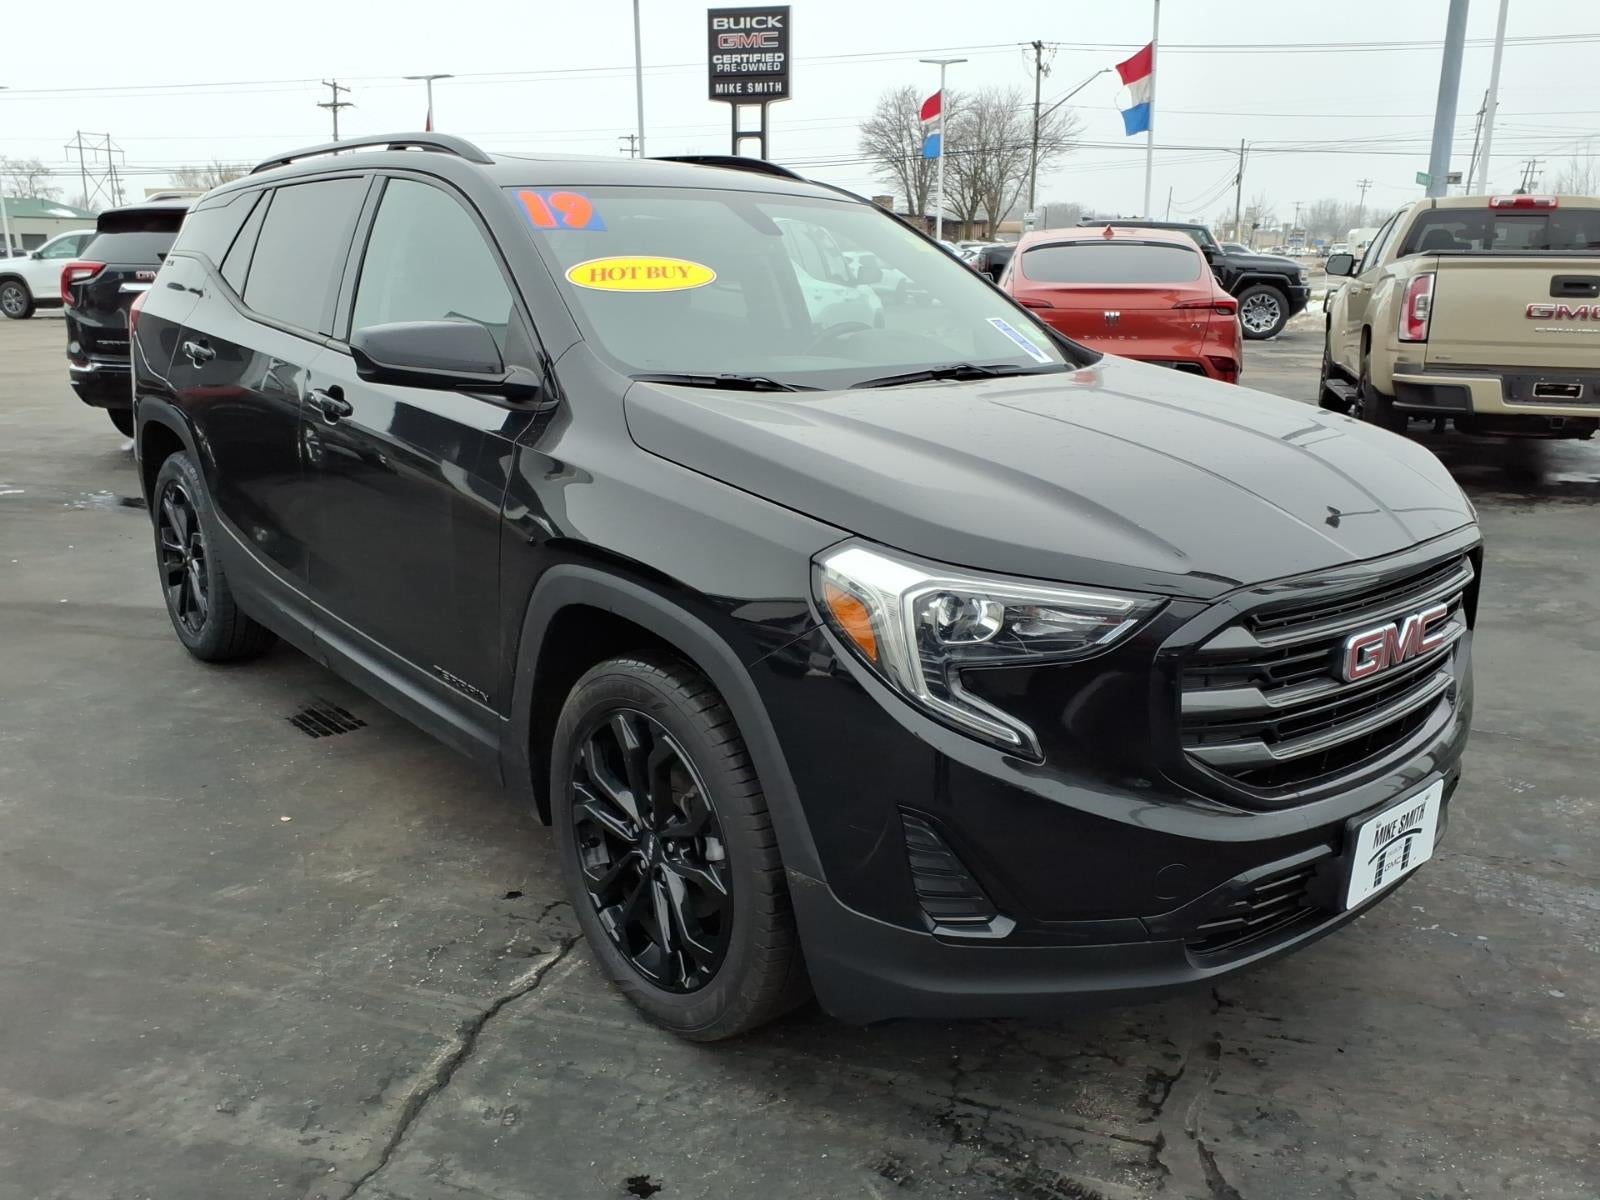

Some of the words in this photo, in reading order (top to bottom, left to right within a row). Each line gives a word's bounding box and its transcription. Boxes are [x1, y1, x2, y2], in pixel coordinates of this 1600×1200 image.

[712, 15, 784, 30] BUICK
[718, 31, 779, 49] GMC
[712, 53, 784, 64] CERTIFIED
[716, 62, 781, 72] PRE-OWNED
[715, 83, 742, 94] MIKE
[747, 82, 782, 93] SMITH
[518, 190, 594, 229] 19
[590, 266, 642, 283] HOT
[646, 265, 692, 280] BUY
[1343, 603, 1448, 683] GMC
[1373, 819, 1399, 849] MIKE
[1398, 802, 1426, 834] SMITH
